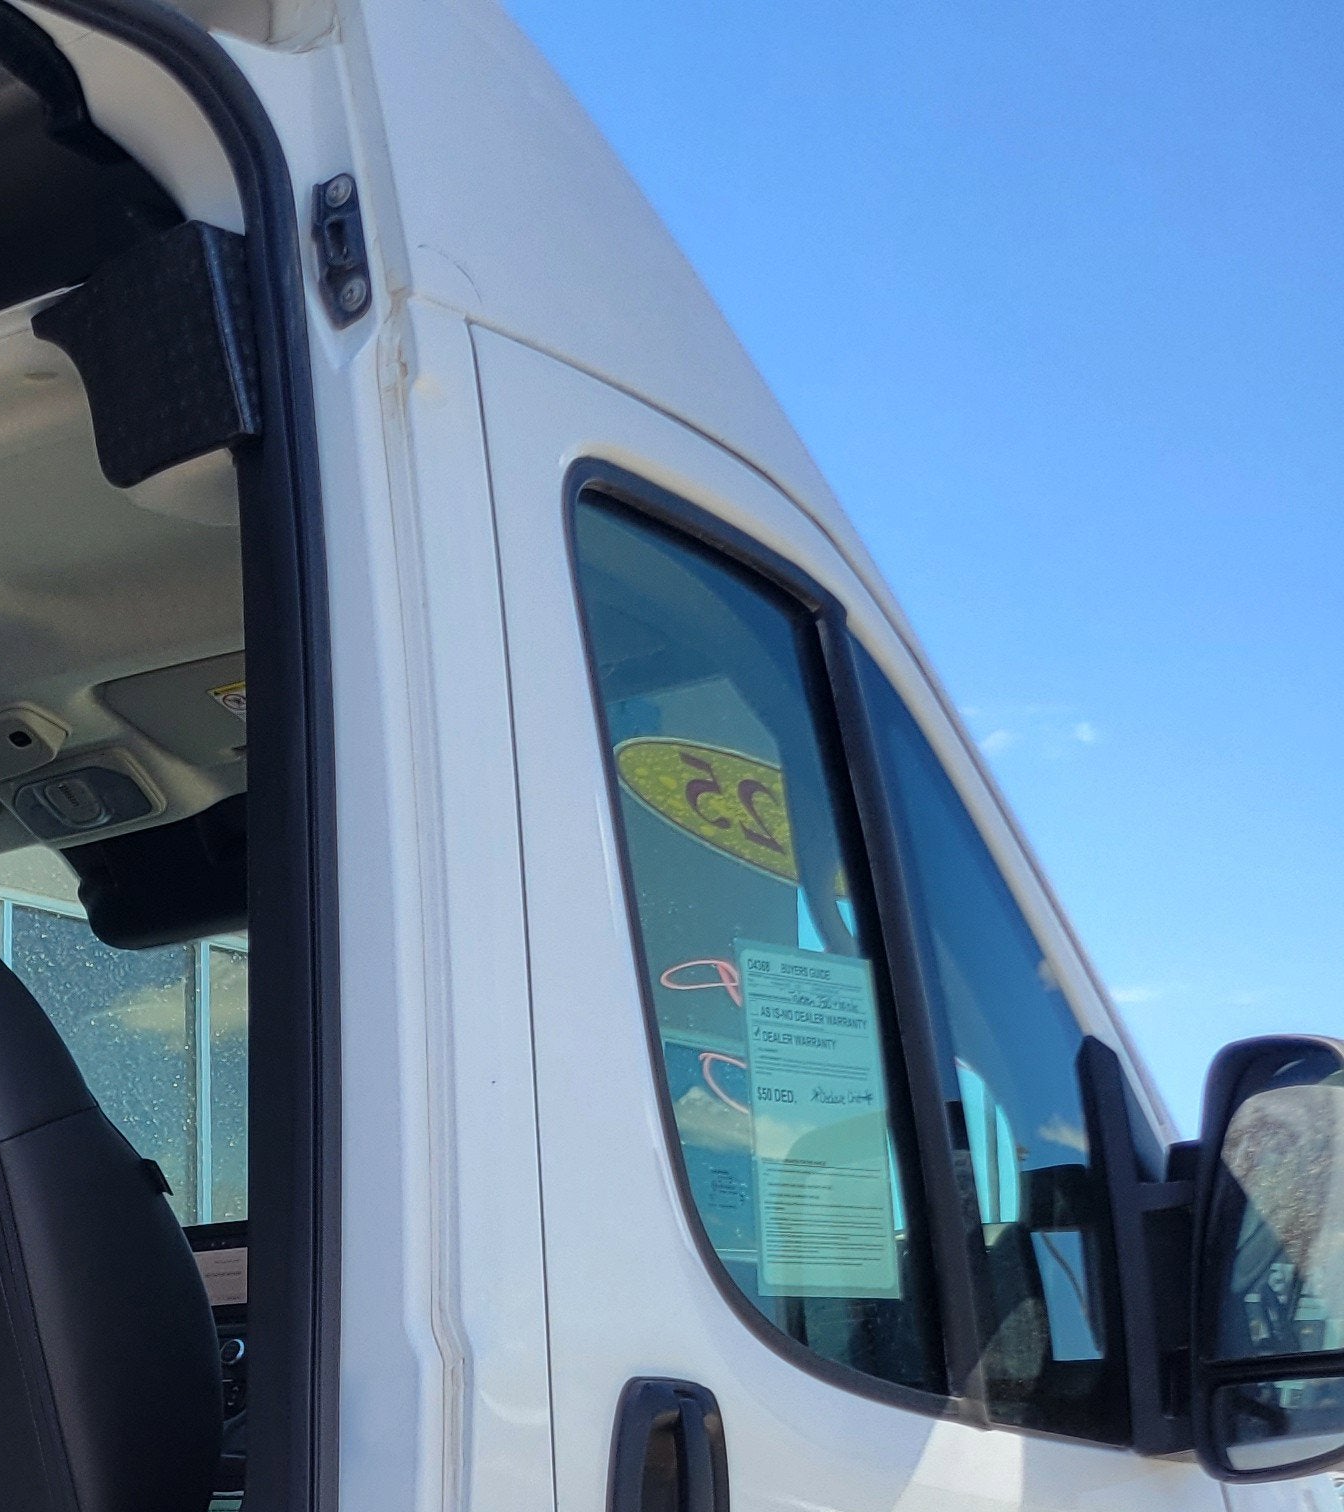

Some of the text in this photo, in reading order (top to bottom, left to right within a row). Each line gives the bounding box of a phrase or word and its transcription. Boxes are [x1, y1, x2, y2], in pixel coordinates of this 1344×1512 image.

[780, 963, 808, 977] BUYERS
[809, 968, 831, 980] GUIDE
[760, 1006, 771, 1018] AS
[794, 1010, 824, 1024] DEALER
[825, 1015, 867, 1029] WARRANTY
[762, 1031, 836, 1050] DEALER WARRANTY
[756, 1086, 772, 1101] $50
[774, 1088, 798, 1104] DED.
